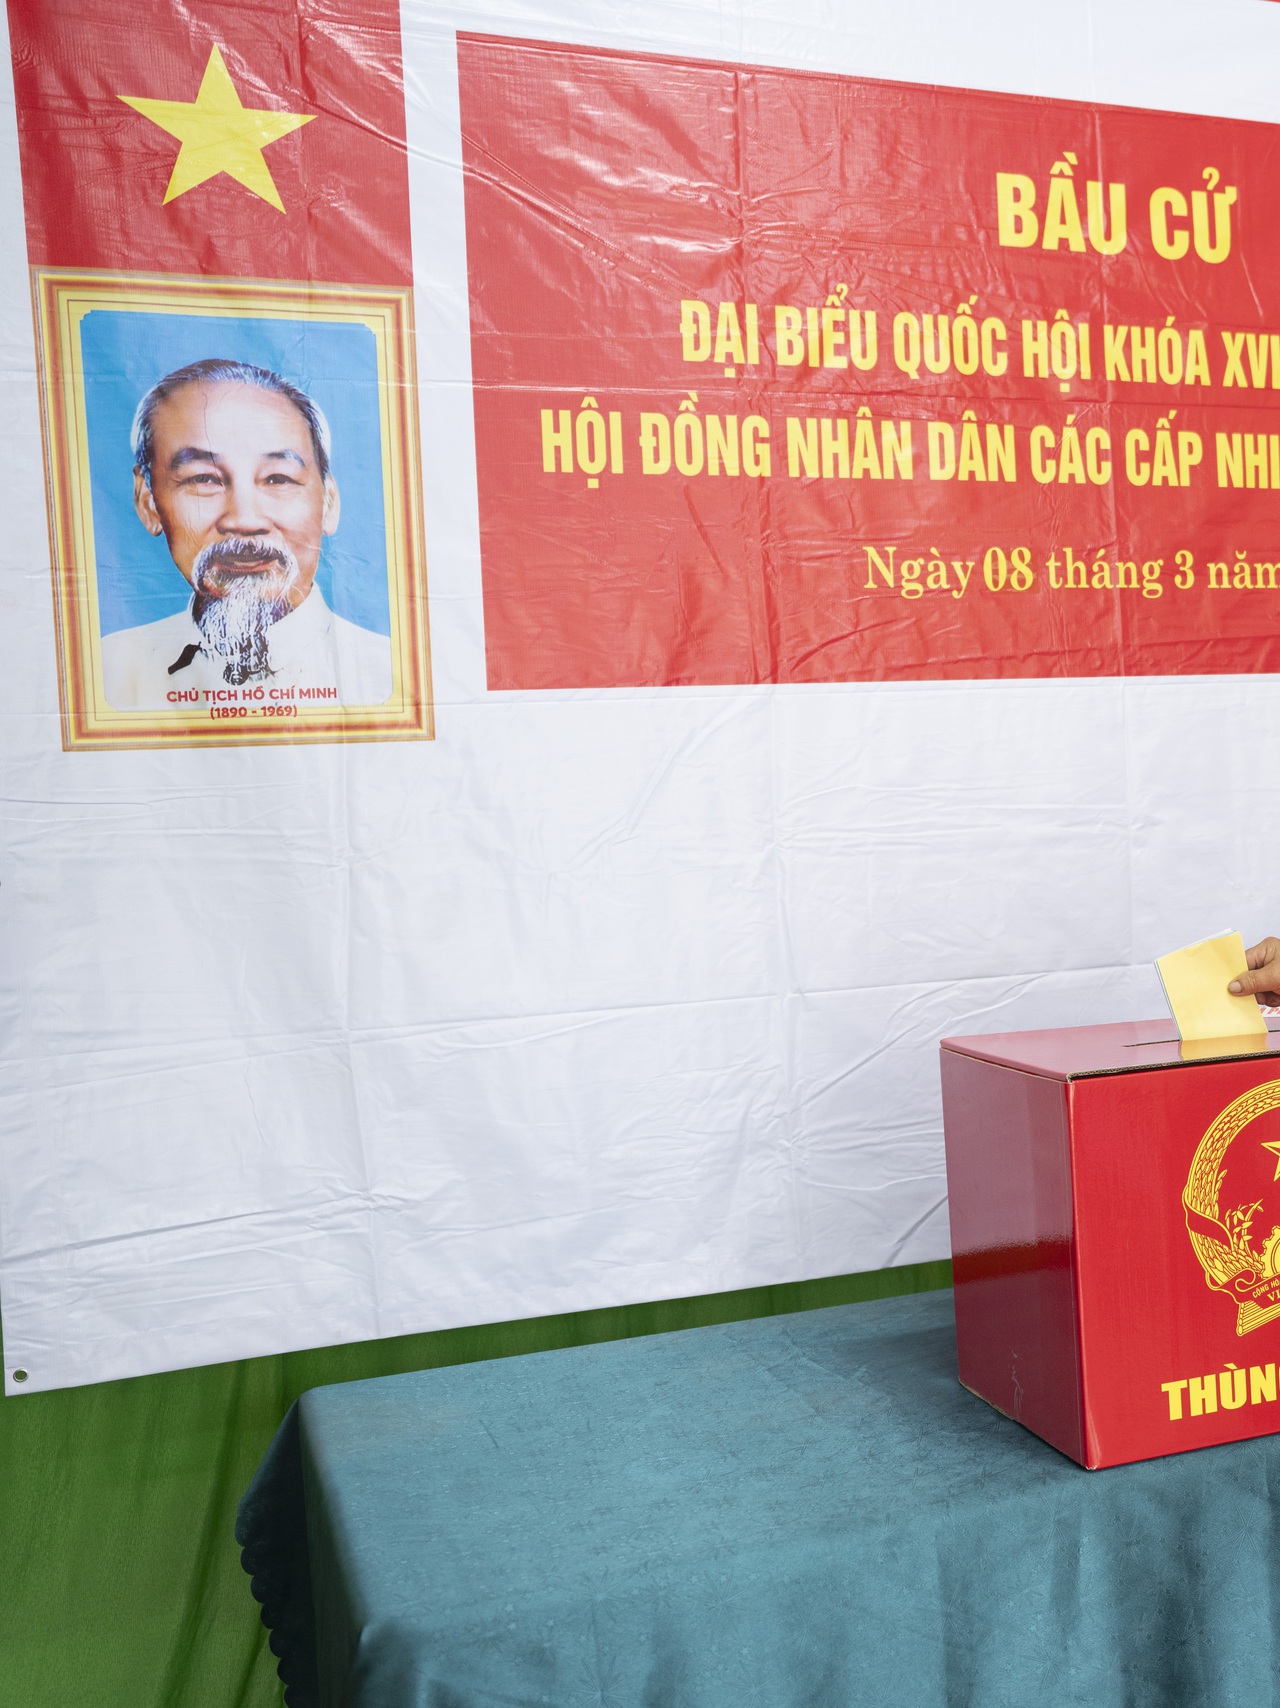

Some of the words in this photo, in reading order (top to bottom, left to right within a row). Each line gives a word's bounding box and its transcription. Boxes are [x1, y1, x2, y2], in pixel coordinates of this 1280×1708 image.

[995, 151, 1128, 256] BẦU
[1149, 166, 1238, 264] CỬ
[679, 299, 760, 378] ĐẠI
[774, 282, 879, 371] BIỂU
[892, 294, 1009, 380] QUỐC
[1021, 308, 1092, 393] HỘI
[1102, 315, 1212, 387] KHÓA
[540, 395, 624, 489] HỘI
[638, 391, 772, 478] ĐỒNG
[785, 405, 914, 481] NHÂN
[927, 409, 1017, 483] DÂN
[1029, 413, 1112, 486] CÁC
[1124, 409, 1204, 487] CẤP
[862, 545, 976, 600] Ngày
[982, 545, 1035, 593] 08
[1045, 546, 1165, 599] tháng
[1173, 549, 1195, 590] 3
[166, 687, 199, 702] CHỦ
[203, 689, 238, 704] TỊCH
[242, 685, 265, 700] HỒ
[269, 686, 295, 699] CHÍ
[299, 688, 337, 699] MINH
[210, 706, 248, 720] (1890
[261, 705, 298, 717] 1969)
[1252, 1283, 1270, 1298] CỘNG
